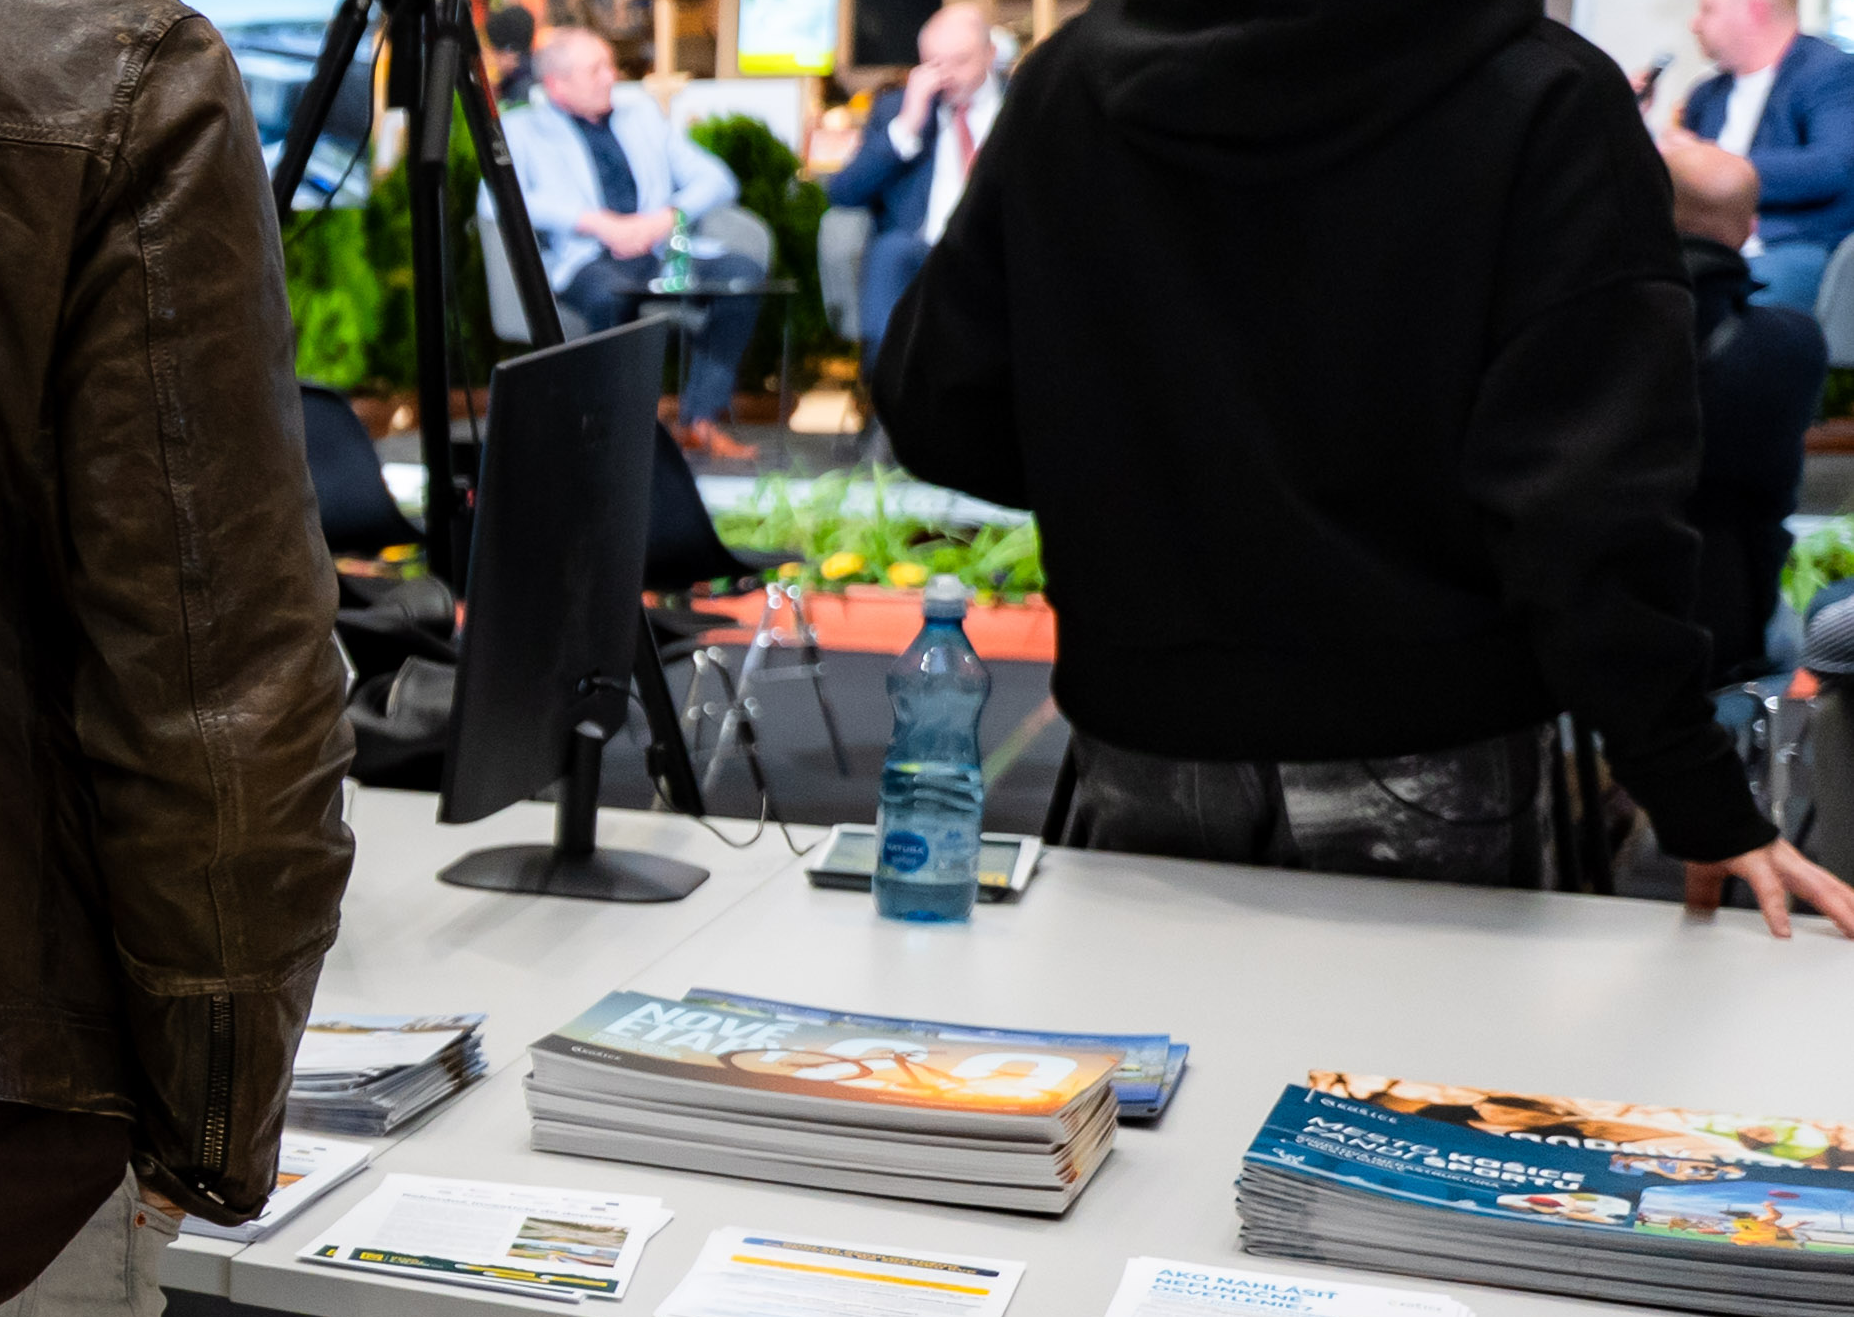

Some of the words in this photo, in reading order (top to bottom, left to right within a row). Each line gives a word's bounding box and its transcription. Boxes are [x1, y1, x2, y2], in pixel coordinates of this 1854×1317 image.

[1306, 1116, 1440, 1157] MESTO
[1448, 1152, 1586, 1182] KOŠICE
[1422, 1155, 1580, 1190] ŠPORTU
[1158, 1269, 1210, 1283] AKO
[1216, 1273, 1339, 1300] NAHLÁSIŤ
